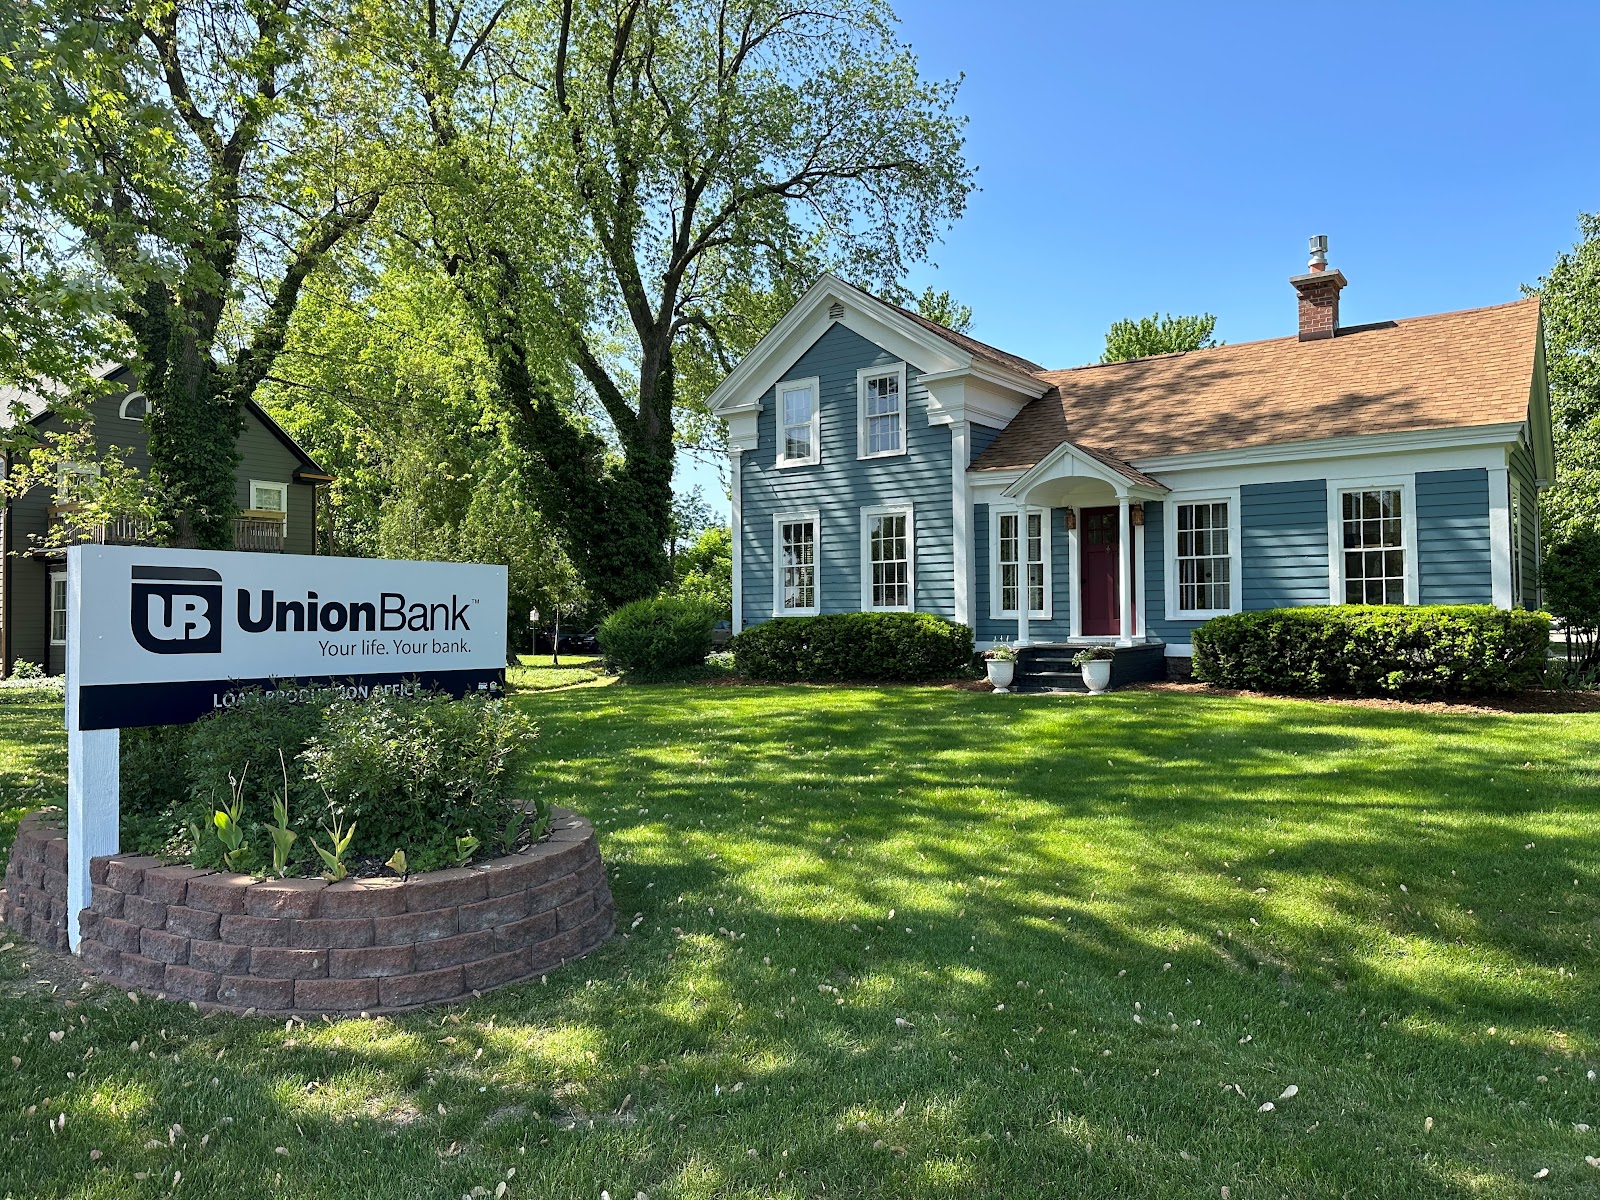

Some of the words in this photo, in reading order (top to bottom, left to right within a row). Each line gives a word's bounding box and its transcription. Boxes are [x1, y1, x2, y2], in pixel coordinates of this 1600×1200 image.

[147, 593, 212, 641] UB
[237, 588, 471, 634] UnionBank
[318, 640, 357, 657] Your
[362, 639, 389, 656] life.
[393, 639, 428, 655] Your
[432, 637, 472, 654] bank.
[213, 691, 259, 708] LOA
[372, 683, 421, 699] FFICE
